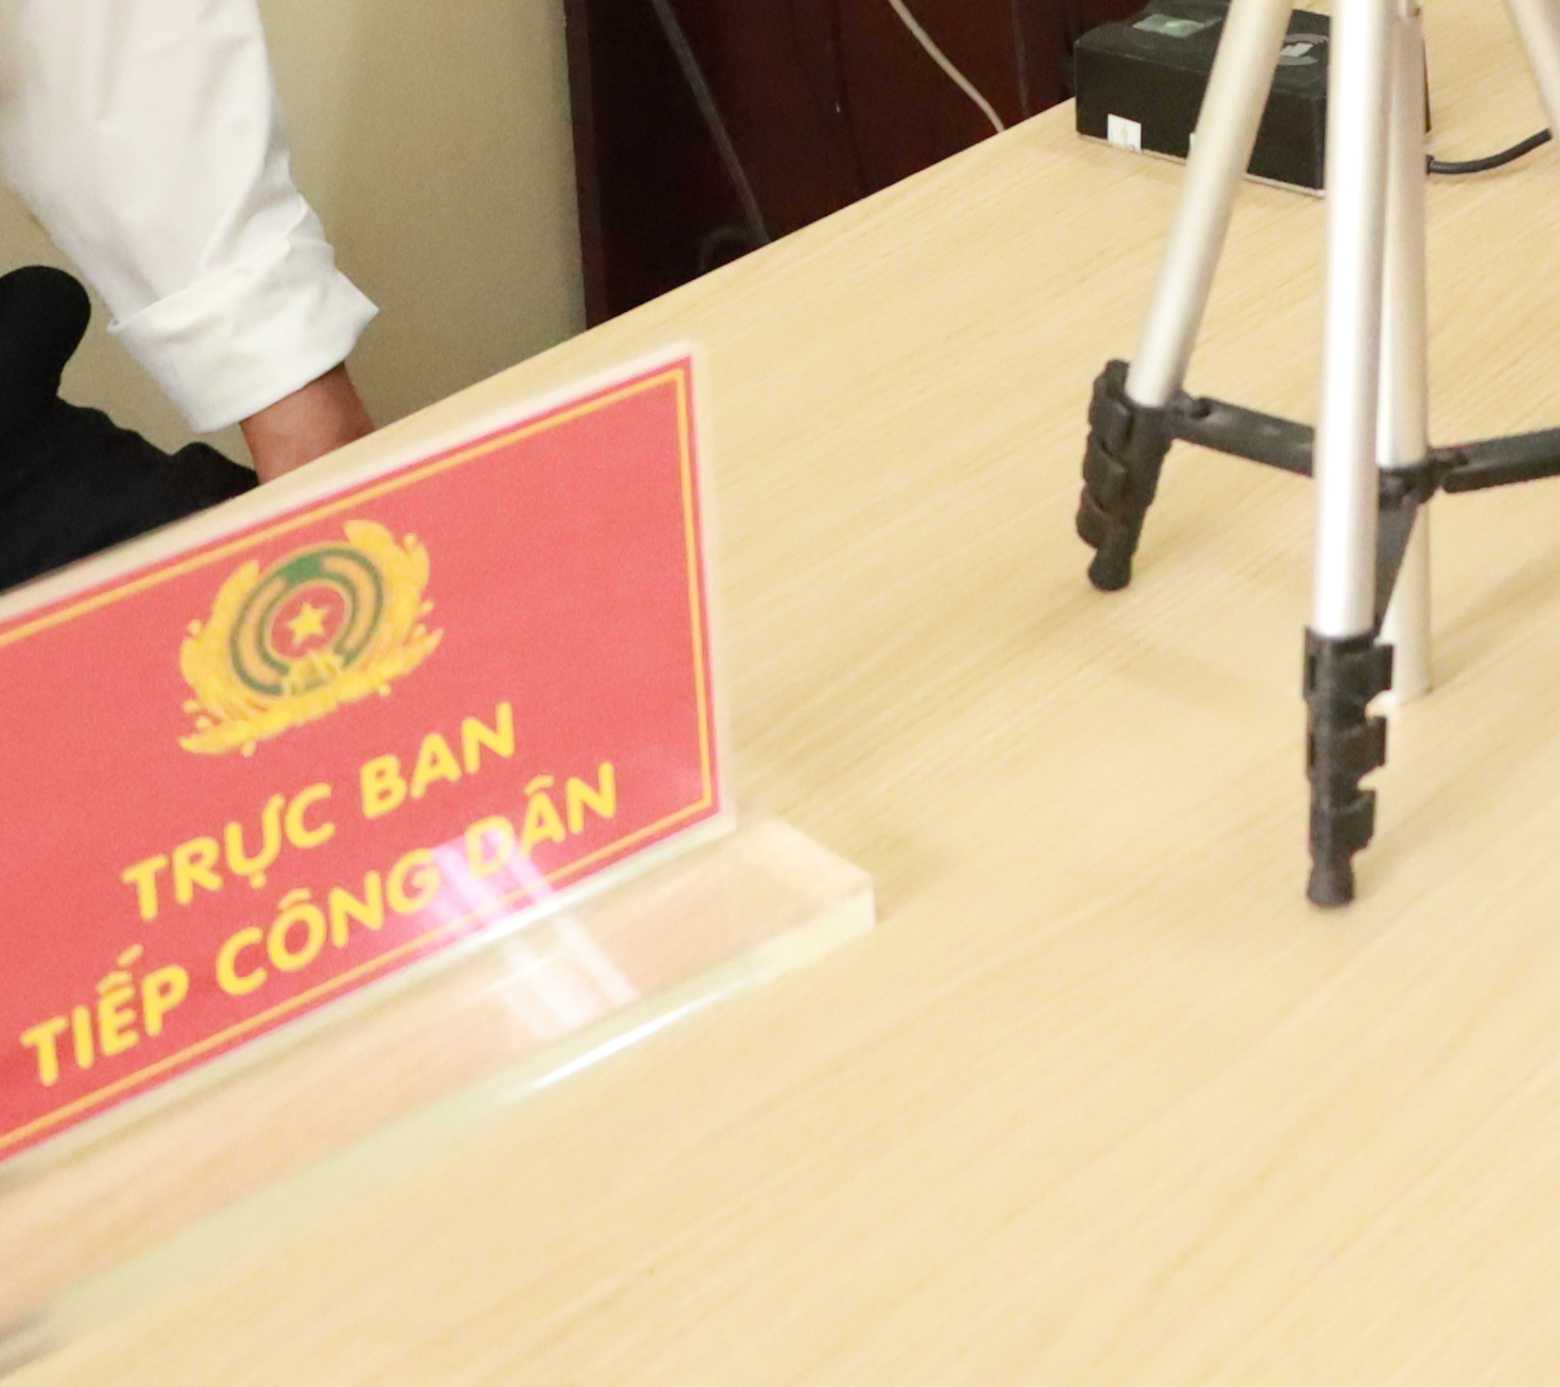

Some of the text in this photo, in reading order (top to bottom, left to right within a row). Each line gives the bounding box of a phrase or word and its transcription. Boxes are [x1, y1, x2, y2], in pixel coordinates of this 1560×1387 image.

[20, 762, 618, 1086] TIẾP CÔNG DÂN
[122, 702, 517, 922] TRỰC BAN
